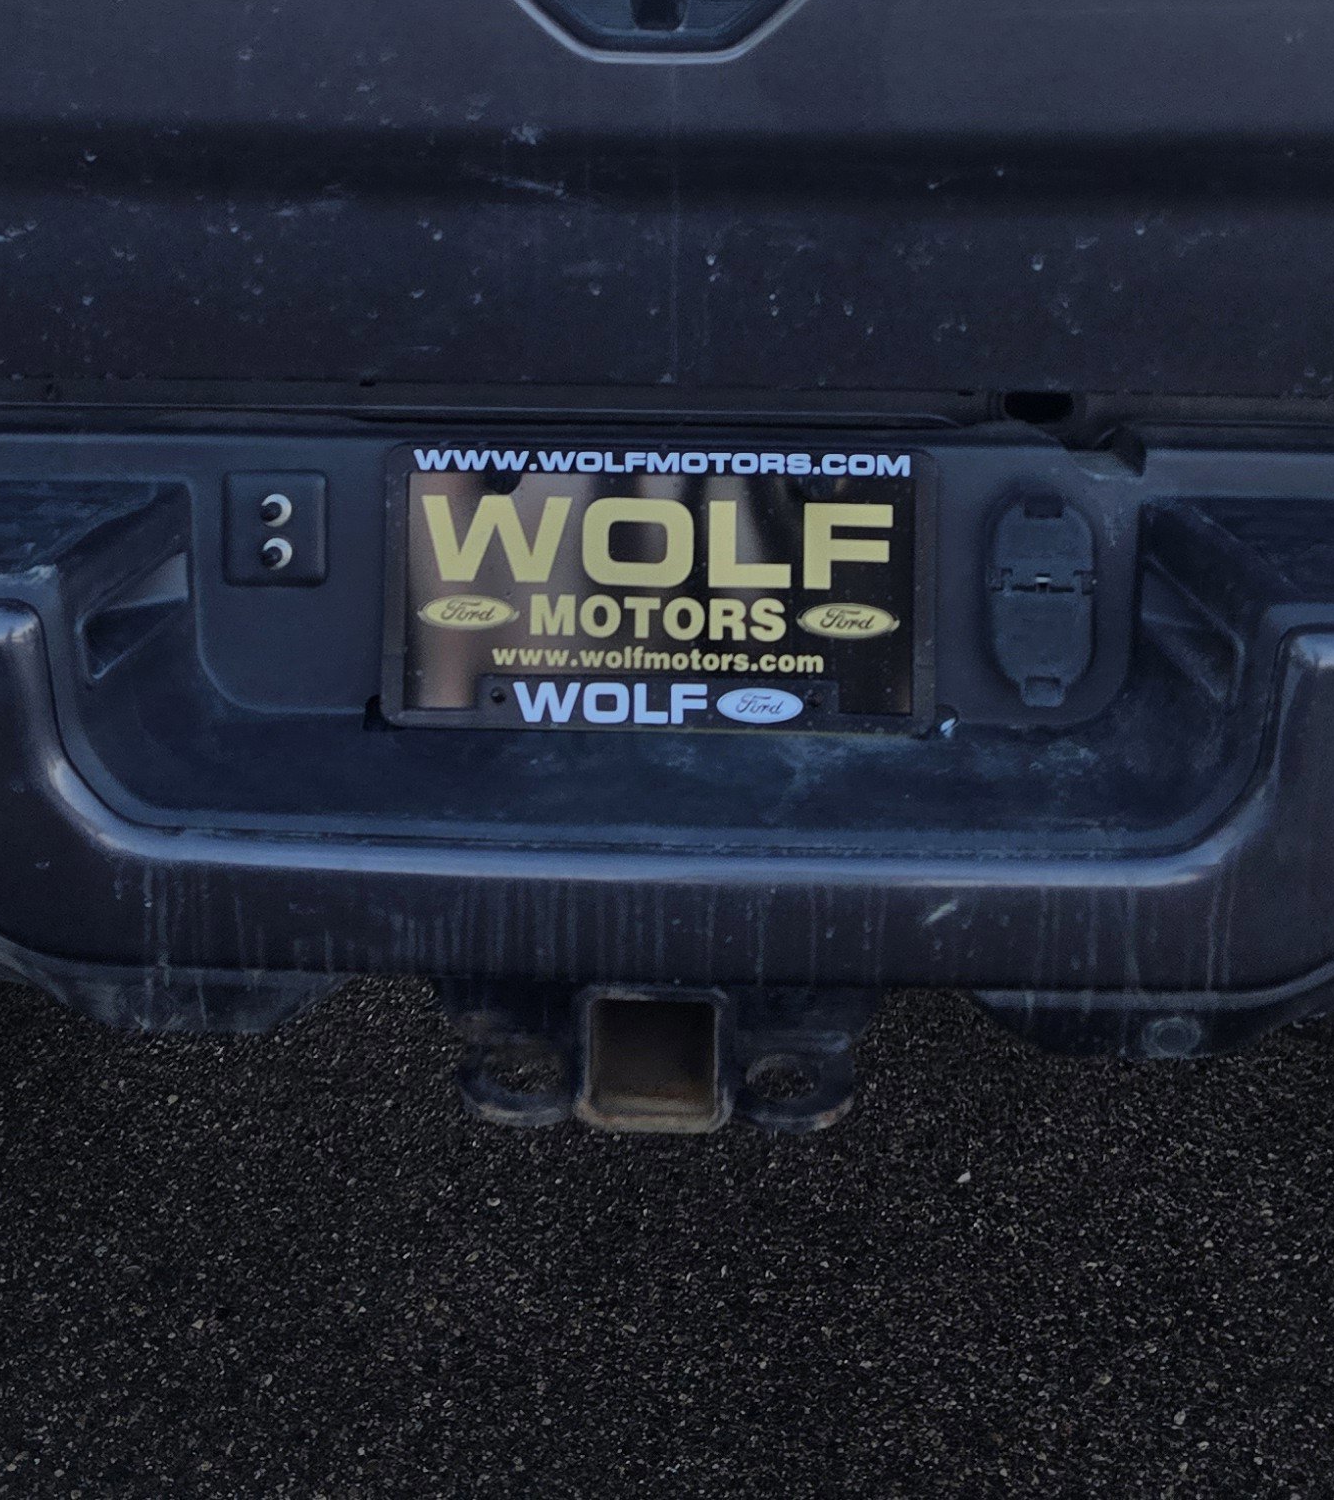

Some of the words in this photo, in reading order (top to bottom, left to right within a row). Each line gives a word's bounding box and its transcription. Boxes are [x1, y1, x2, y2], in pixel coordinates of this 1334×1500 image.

[413, 447, 912, 477] WWW.WOLFMOTORS.COM
[421, 494, 894, 590] WOLF
[440, 599, 496, 621] Ford
[529, 594, 787, 642] MOTORS
[820, 607, 875, 629] Ford
[492, 646, 825, 673] www.wolfmotors.com
[513, 681, 709, 724] WOLF
[735, 691, 784, 715] Ford
